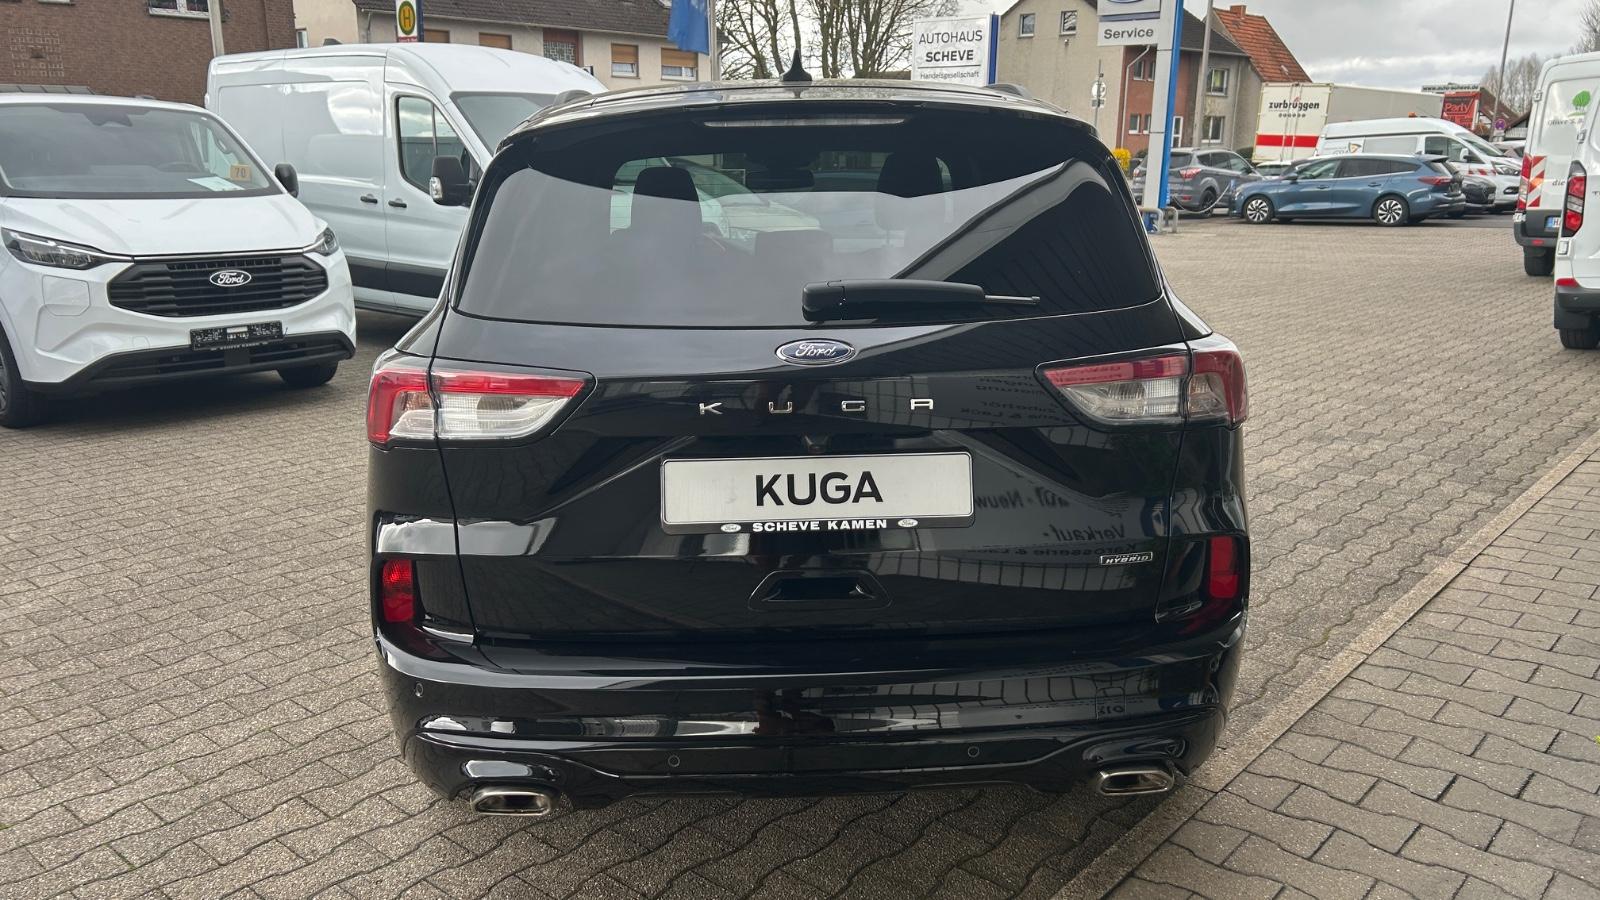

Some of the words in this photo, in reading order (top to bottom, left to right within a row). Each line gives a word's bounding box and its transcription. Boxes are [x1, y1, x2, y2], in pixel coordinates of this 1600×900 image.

[918, 30, 983, 45] AUTOHAUS
[1104, 28, 1154, 40] Service
[925, 49, 974, 62] SCHEVE
[920, 70, 979, 79] Handelsgesellschaft
[755, 470, 884, 507] KUGA
[752, 521, 820, 532] SCHEVE
[827, 519, 888, 530] KAMEN
[1106, 555, 1149, 564] HYBRID
